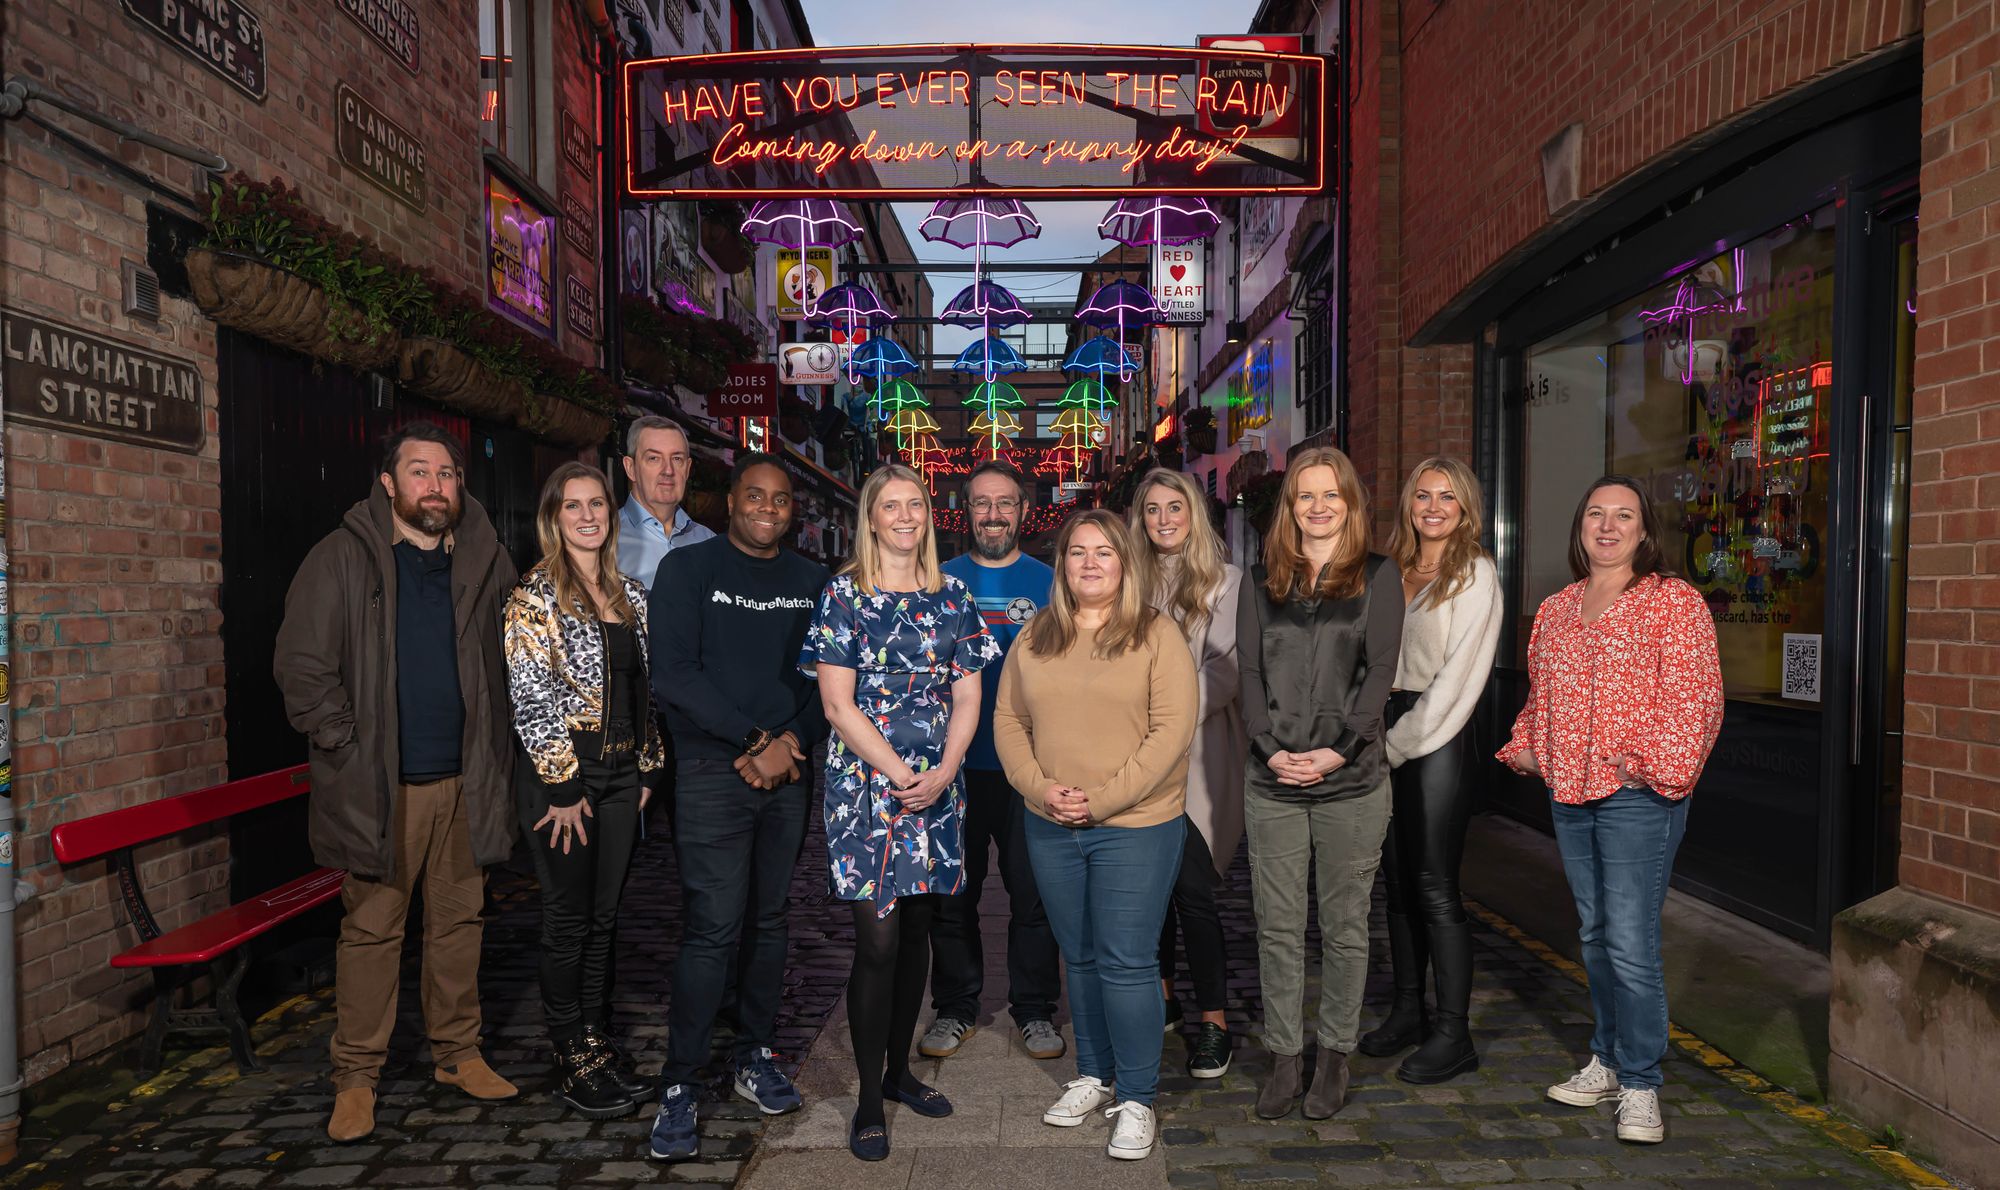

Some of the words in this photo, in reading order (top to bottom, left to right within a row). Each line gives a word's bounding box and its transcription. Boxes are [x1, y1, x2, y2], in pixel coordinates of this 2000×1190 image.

[162, 0, 238, 72] PLACE
[1213, 68, 1263, 79] GUINNESS
[665, 82, 764, 123] HAVE
[783, 73, 859, 112] YOU
[876, 70, 970, 105] EVER
[995, 70, 1085, 104] SEEN
[1105, 72, 1179, 108] THE
[1197, 76, 1287, 117] RAIN
[713, 122, 845, 174] Coming
[850, 129, 948, 160] down
[955, 139, 1002, 160] on
[1006, 139, 1037, 158] a
[1042, 138, 1152, 173] sunny
[1155, 124, 1249, 172] day?
[362, 139, 412, 194] DRIVE
[1162, 250, 1194, 262] RED
[1153, 285, 1204, 297] HEART
[1154, 311, 1203, 321] GINNESS
[4, 320, 195, 402] LANCHATTAN
[725, 375, 767, 387] ADIES
[1538, 373, 1549, 398] is
[40, 377, 157, 432] STREET
[720, 393, 763, 404] ROOM
[735, 595, 814, 611] FutureMatch
[1751, 610, 1769, 623] has
[1772, 610, 1791, 623] the
